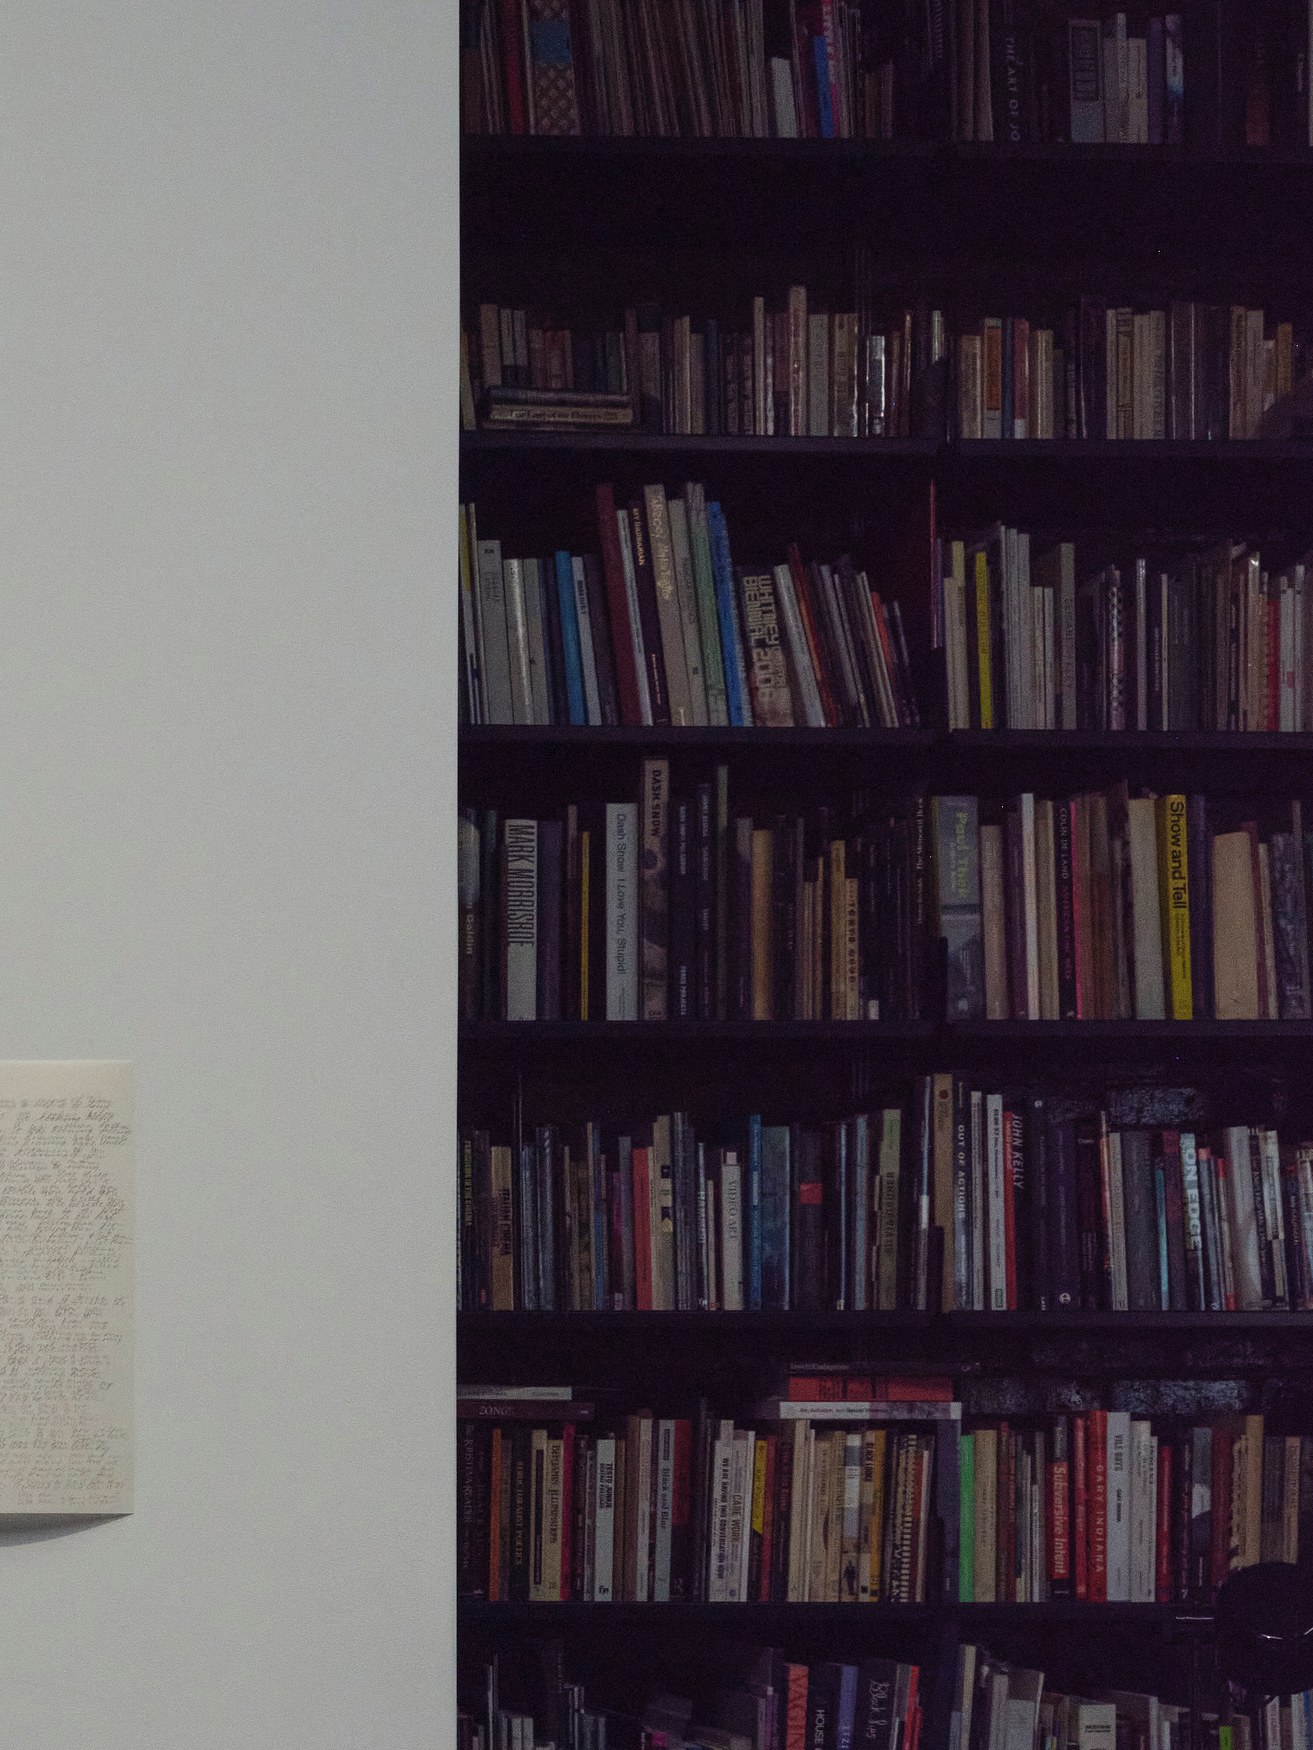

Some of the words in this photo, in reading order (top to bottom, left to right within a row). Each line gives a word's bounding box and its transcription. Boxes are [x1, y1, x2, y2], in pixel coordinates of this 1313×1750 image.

[1007, 67, 1020, 92] ART
[743, 576, 766, 647] BIENNIAL
[757, 575, 781, 645] WHITNEY
[751, 648, 776, 703] 2006
[650, 769, 662, 800] DASH
[616, 813, 627, 840] Dash
[650, 803, 662, 837] SNOW
[955, 812, 970, 850] Paul
[1059, 808, 1068, 837] COLIN
[1169, 801, 1187, 847] Show
[507, 824, 535, 863] MARK
[616, 844, 627, 872] Snow
[1061, 840, 1069, 850] DE
[956, 858, 970, 898] Thek
[1061, 853, 1070, 880] LAND
[1171, 850, 1187, 880] and
[507, 868, 535, 947] MORRISROE
[616, 884, 627, 910] Love
[1172, 885, 1188, 910] Tell
[615, 938, 627, 975] Stupid!
[957, 1125, 966, 1149] OUT
[1012, 1113, 1024, 1146] JOHN
[957, 1152, 966, 1166] OF
[1013, 1151, 1025, 1190] KELLY
[1184, 1152, 1198, 1183] ON
[727, 1179, 738, 1217] VIDEO
[728, 1219, 739, 1241] ART
[1186, 1188, 1202, 1250] EDGE
[1053, 1465, 1067, 1534] Subversive
[1095, 1464, 1104, 1502] GARY
[731, 1494, 743, 1516] CARE
[731, 1518, 742, 1544] WORK
[1095, 1511, 1104, 1573] INDIANA
[1054, 1537, 1067, 1574] Intent
[813, 1709, 826, 1743] HOUSE
